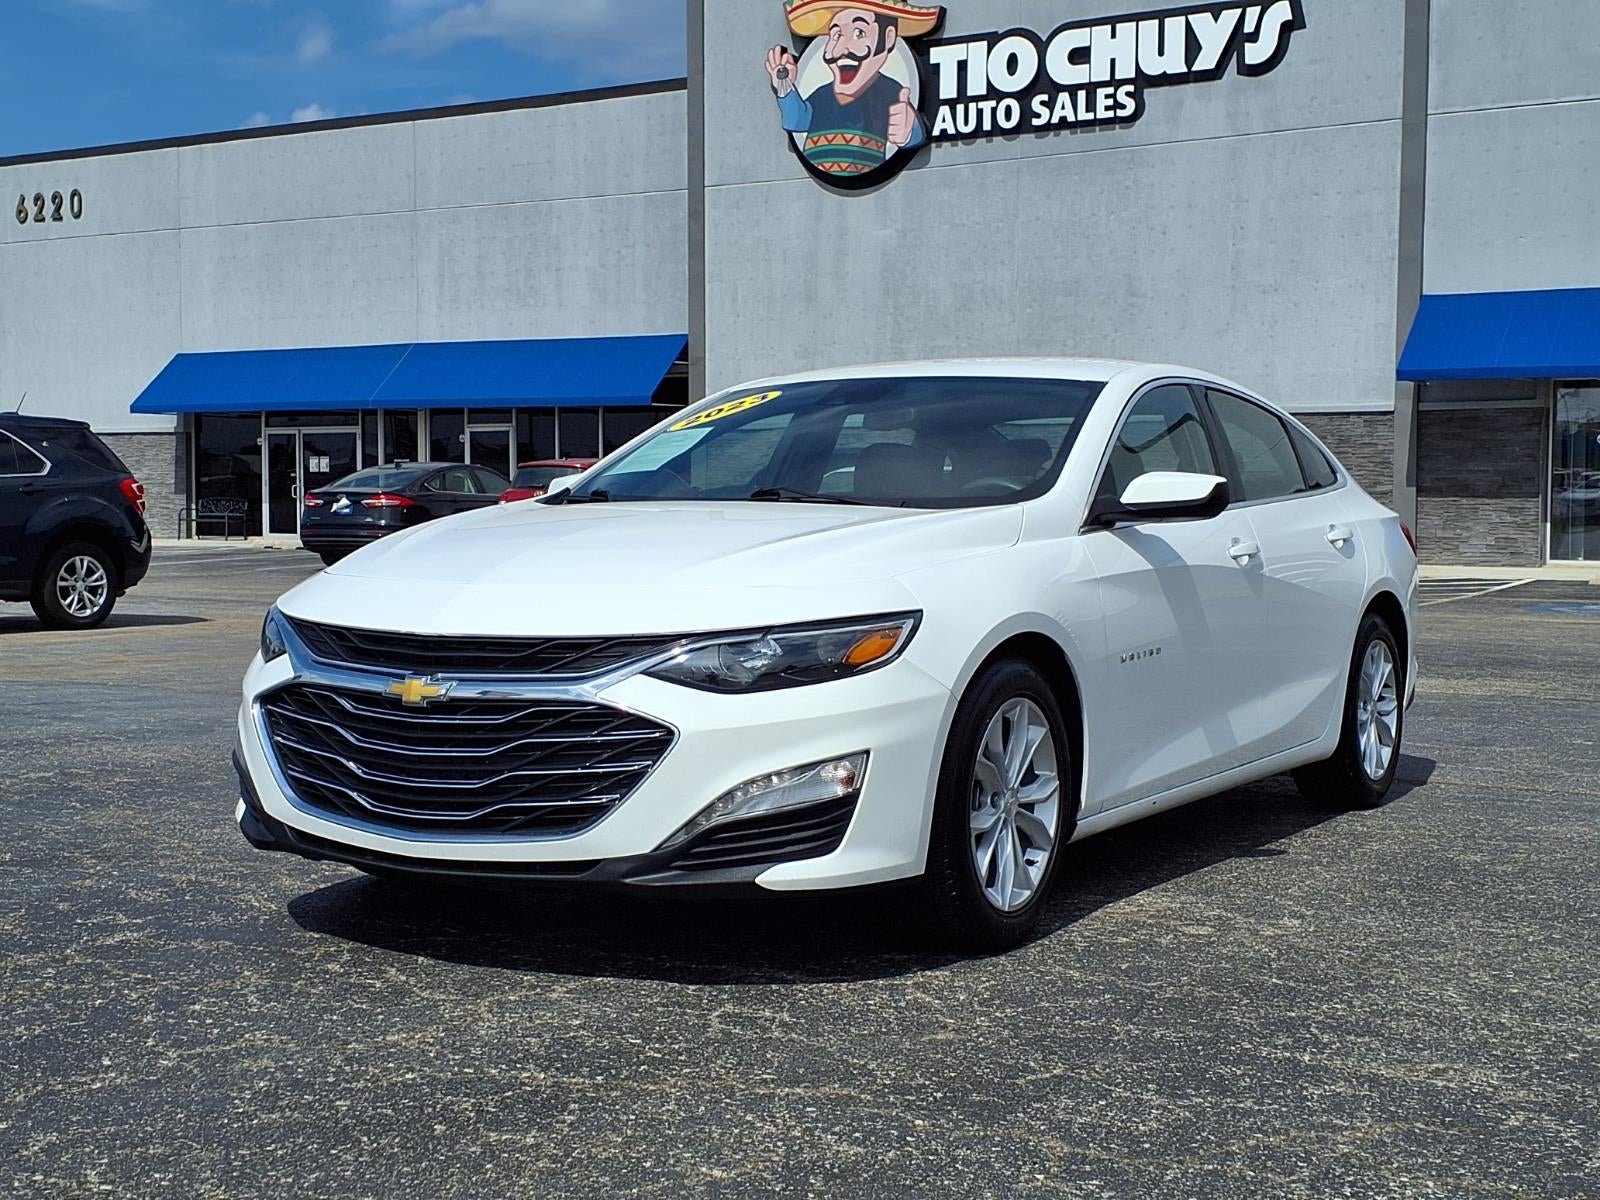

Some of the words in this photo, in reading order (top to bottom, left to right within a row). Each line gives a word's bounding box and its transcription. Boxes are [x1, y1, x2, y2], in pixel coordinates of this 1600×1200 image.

[929, 36, 1039, 100] TIO
[1045, 0, 1293, 86] CHUY'S
[932, 97, 1020, 137] AUTO
[1031, 85, 1136, 126] SALES
[15, 188, 83, 225] 6220
[682, 393, 770, 426] 2023
